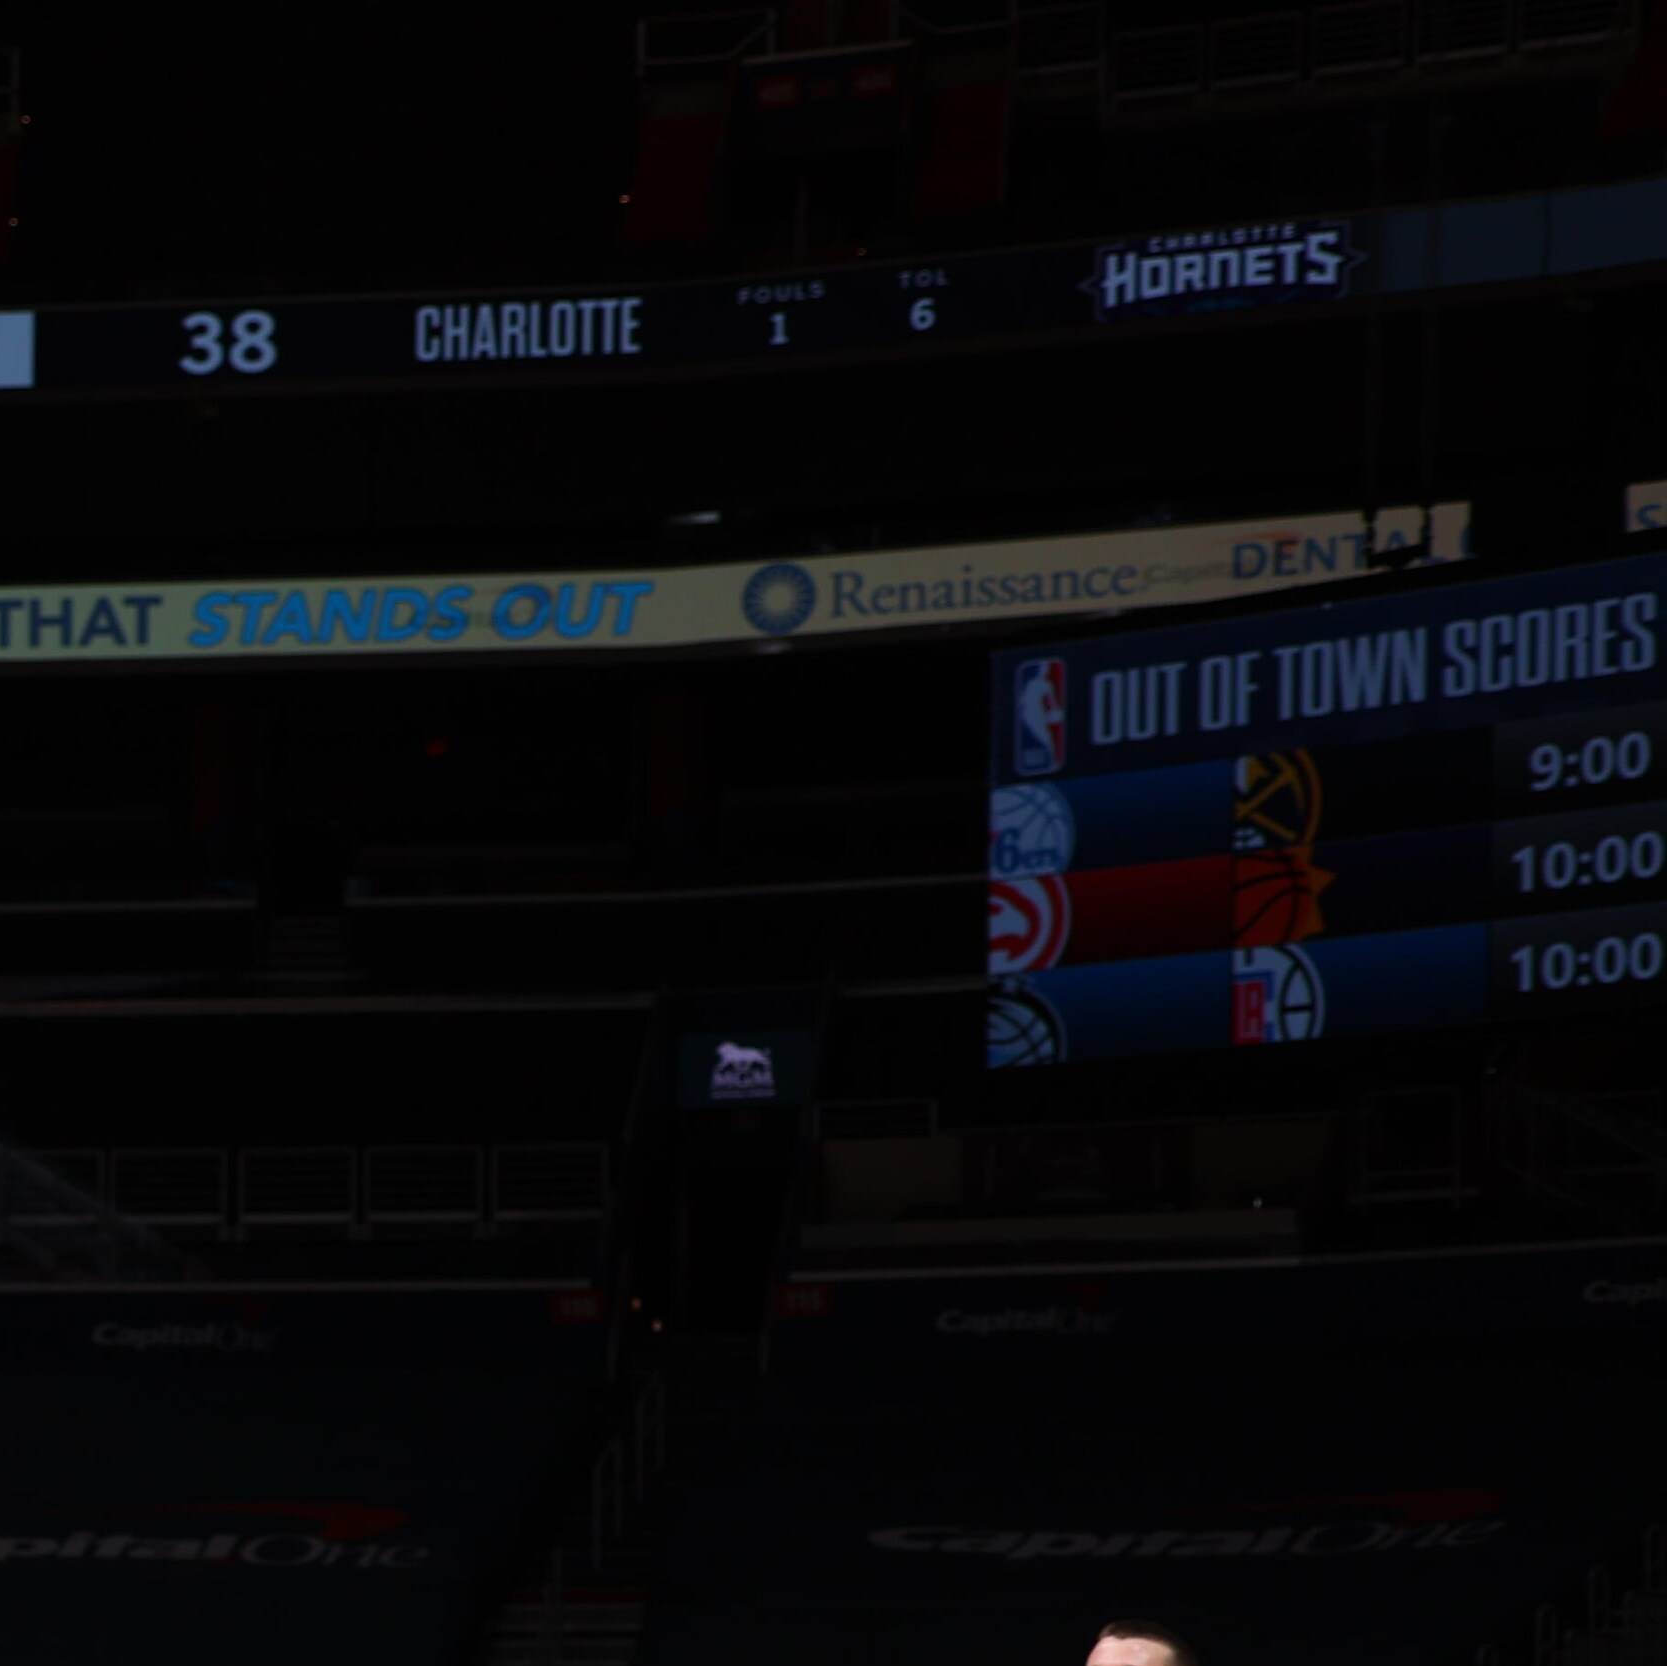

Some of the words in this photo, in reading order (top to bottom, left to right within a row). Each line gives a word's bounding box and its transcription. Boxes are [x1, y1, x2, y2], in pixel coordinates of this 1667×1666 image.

[736, 280, 827, 306] FOULS
[898, 267, 950, 290] TOL
[1101, 230, 1346, 310] HORNETS
[176, 308, 279, 377] 38
[413, 297, 644, 365] CHARLOTTE
[768, 311, 790, 346] 1
[909, 297, 937, 331] 6
[186, 585, 470, 647] STANDS
[495, 580, 654, 640] OUT
[830, 562, 1139, 619] Renaissance
[1091, 660, 1188, 745] OUT
[1197, 649, 1266, 733] OF
[1272, 626, 1429, 722] TOWN
[1440, 591, 1658, 699] SCORES
[1527, 731, 1653, 792] 9:00
[989, 827, 1058, 873] 6ers
[1510, 829, 1665, 895] 10:00
[1509, 931, 1665, 994] 10:00
